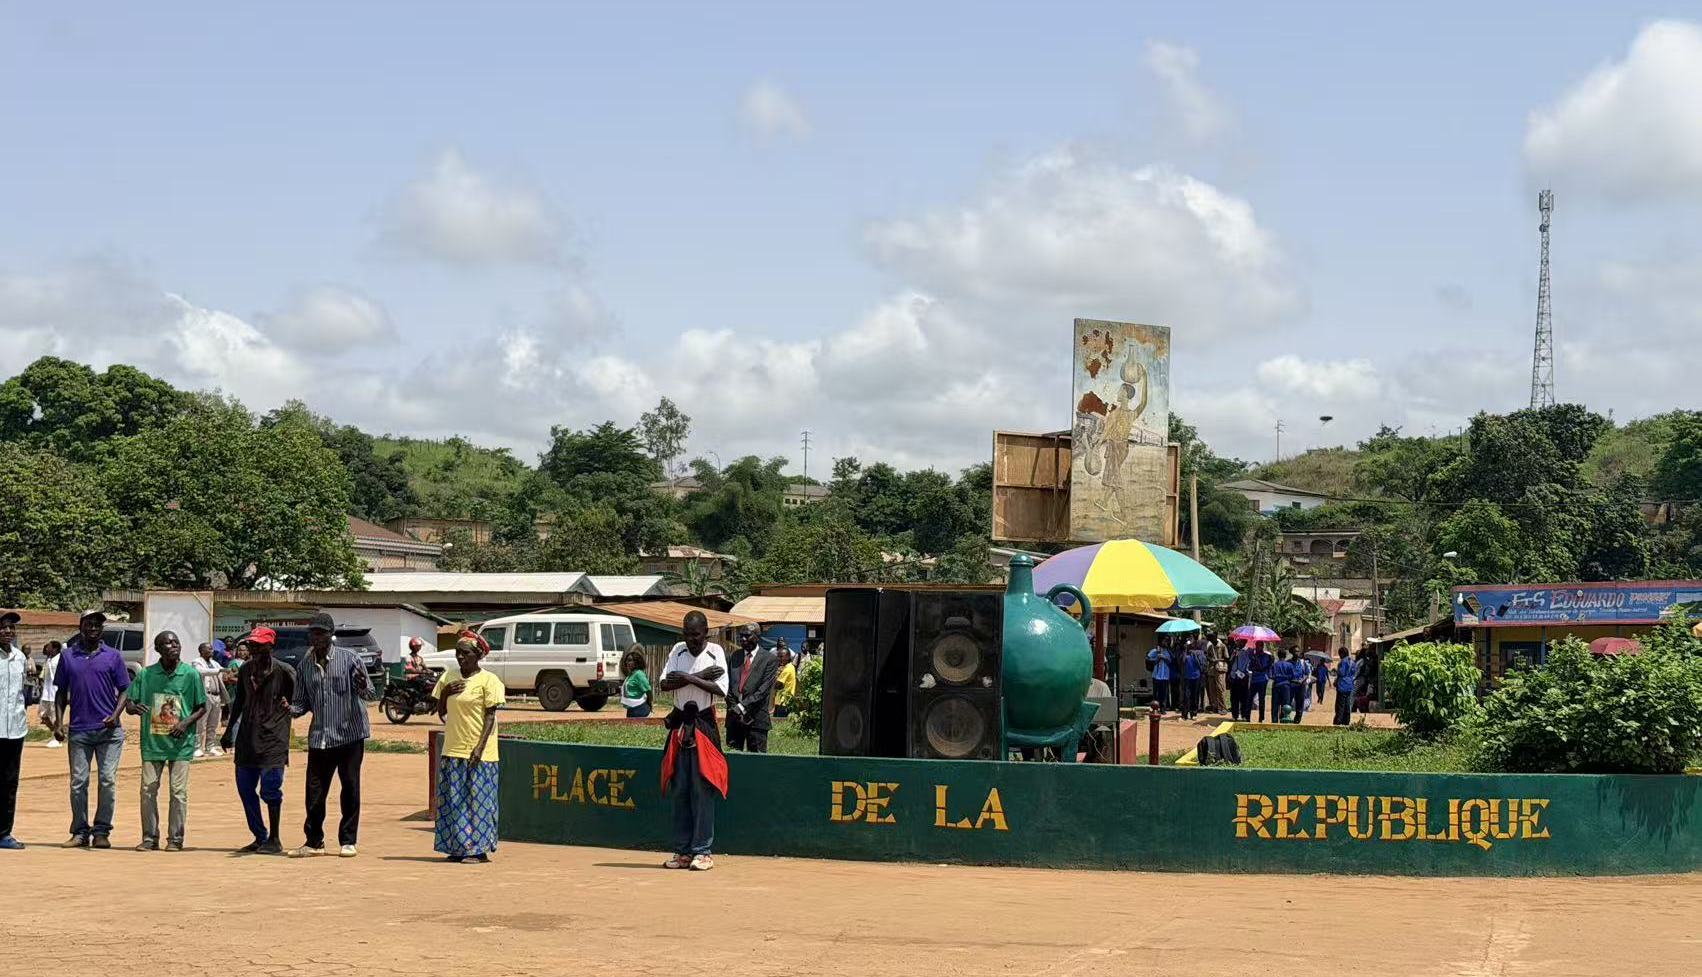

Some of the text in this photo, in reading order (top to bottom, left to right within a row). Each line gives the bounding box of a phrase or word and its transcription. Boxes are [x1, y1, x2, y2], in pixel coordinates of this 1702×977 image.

[532, 764, 1551, 850] PLACE DE LA REPUBLIQUE
